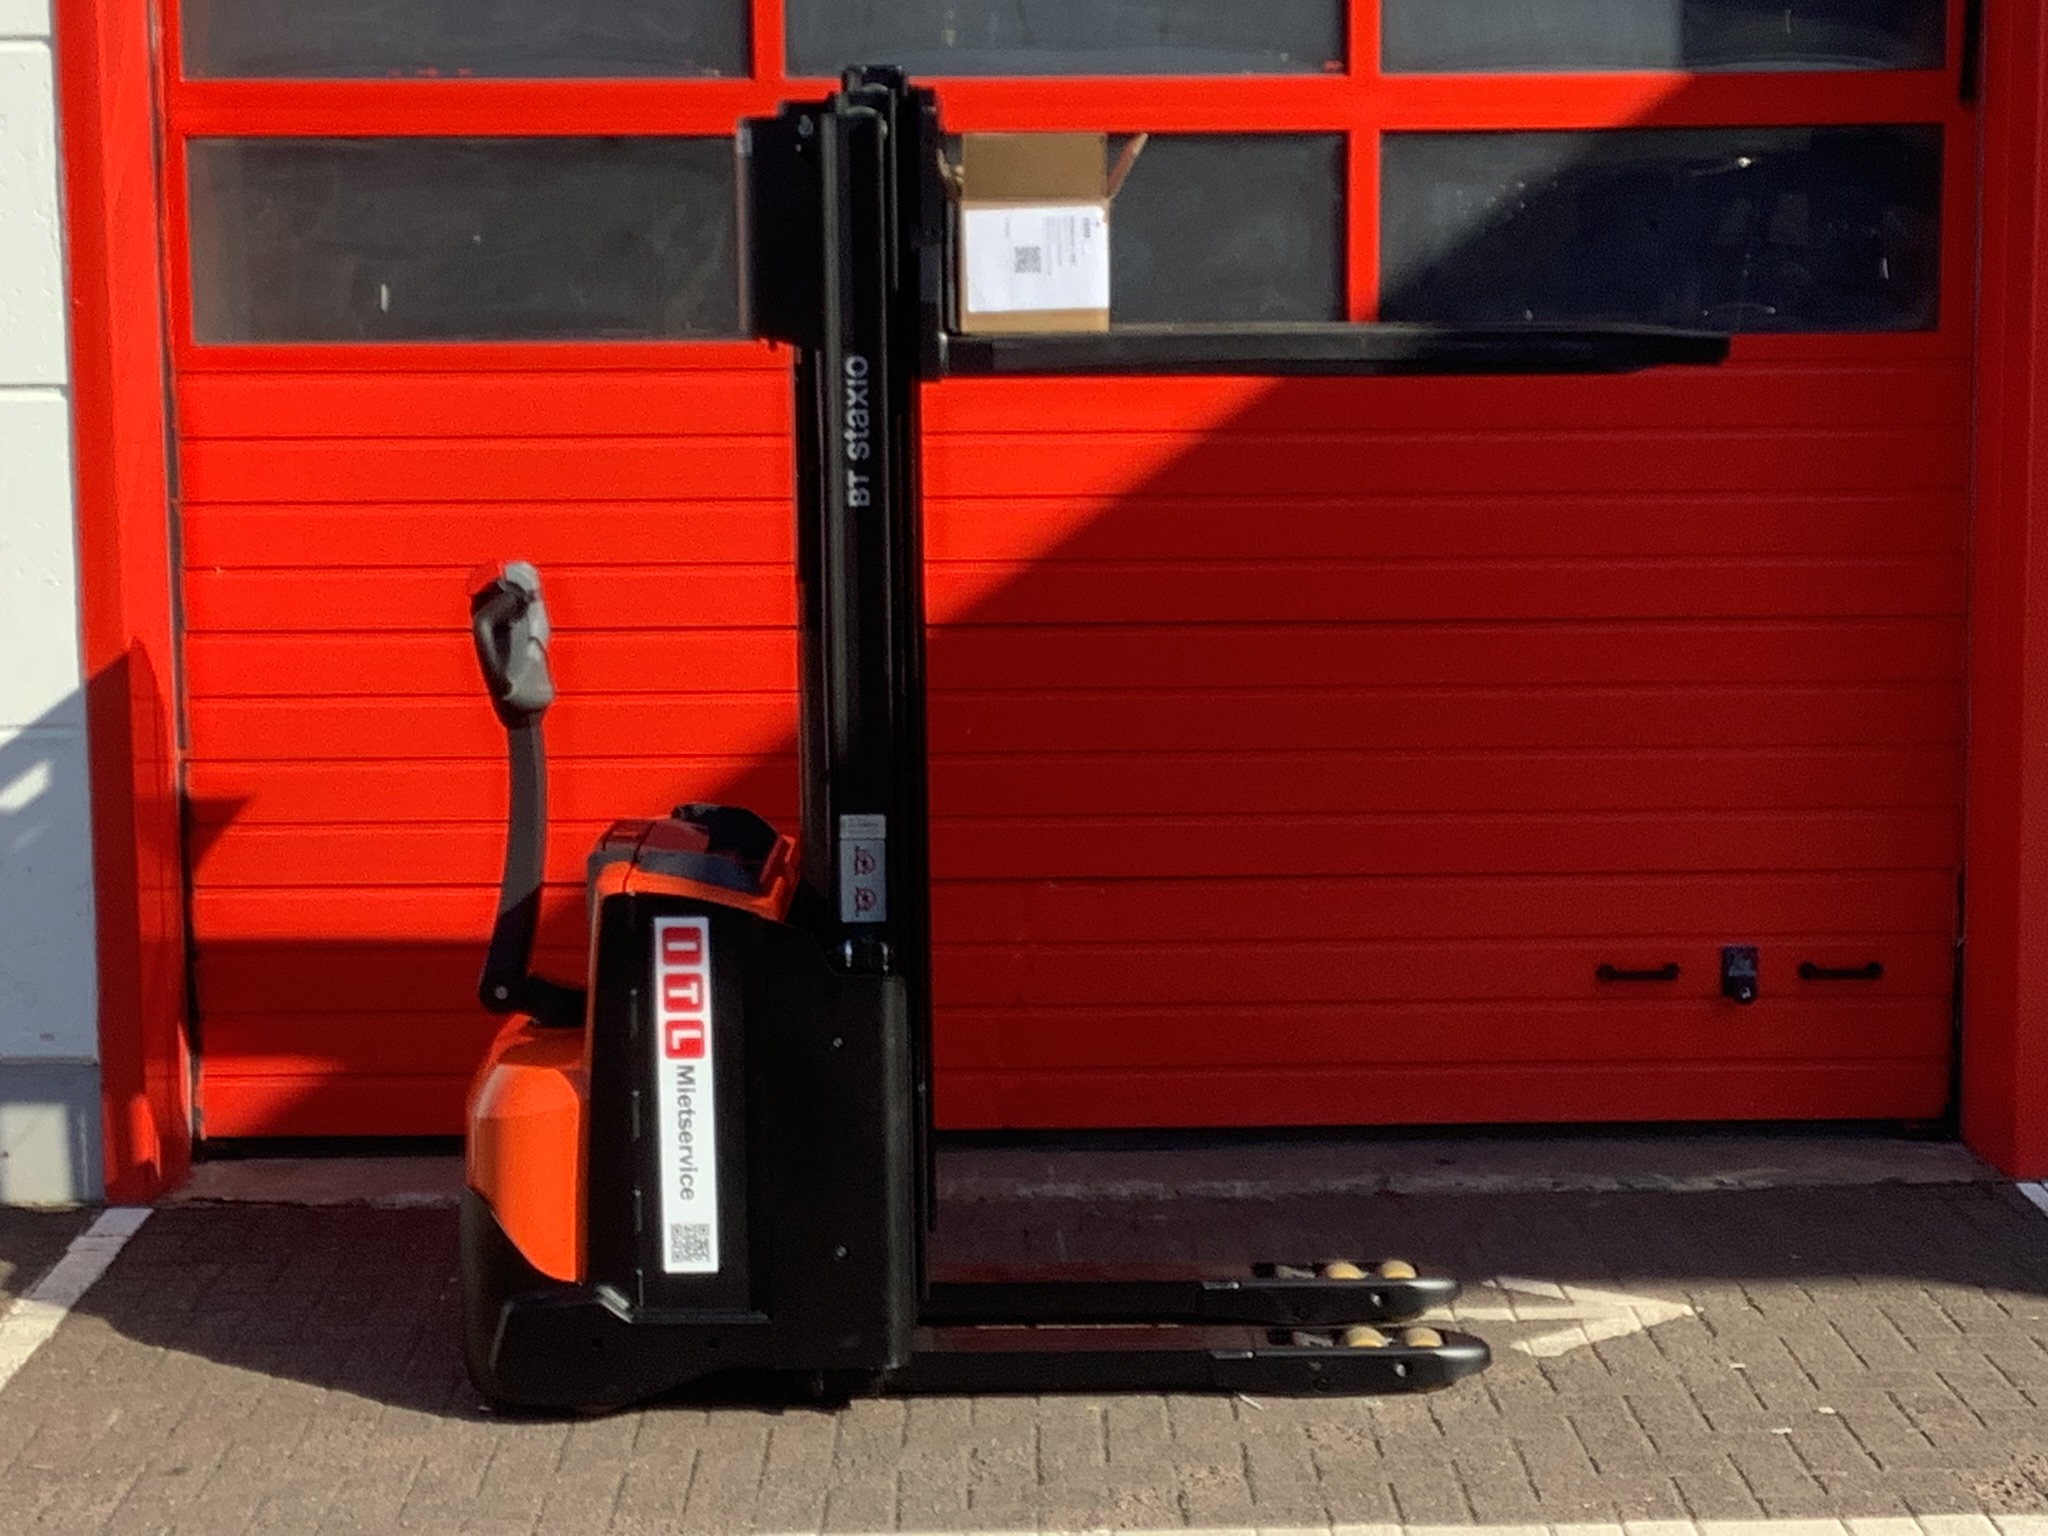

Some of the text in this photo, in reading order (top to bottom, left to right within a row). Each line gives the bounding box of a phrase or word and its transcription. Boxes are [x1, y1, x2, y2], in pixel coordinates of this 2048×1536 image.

[847, 469, 871, 507] BT
[665, 938, 702, 1201] ITL Mietservice
